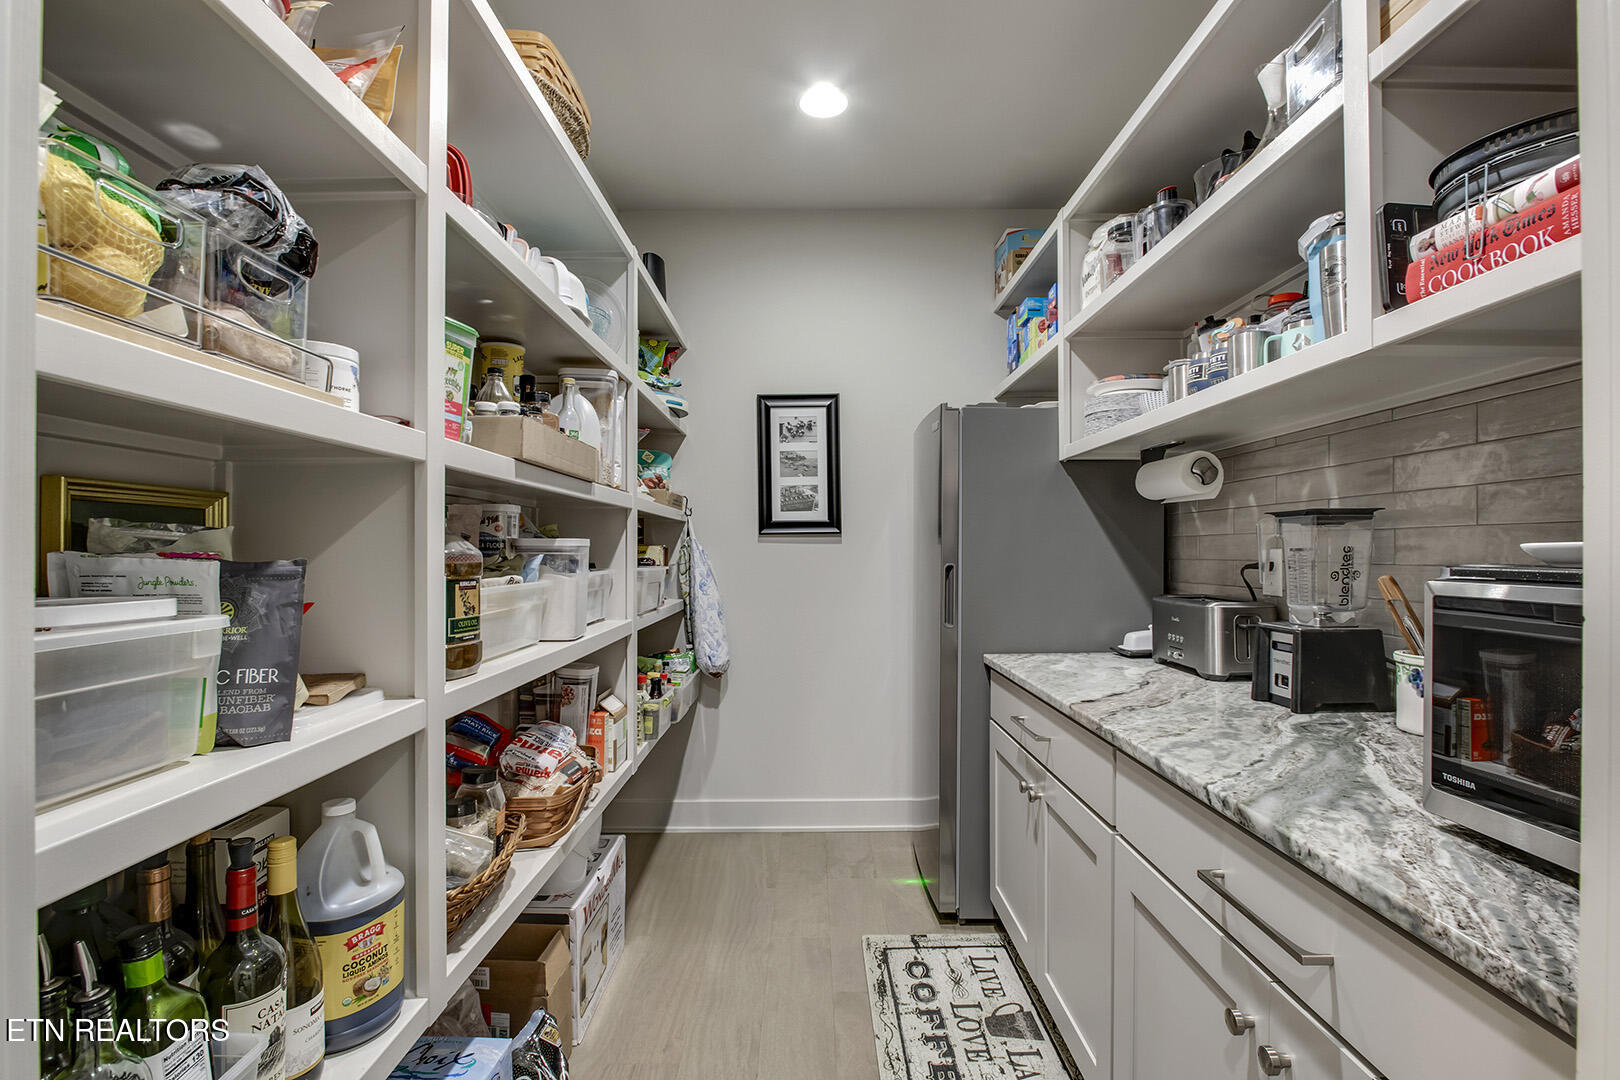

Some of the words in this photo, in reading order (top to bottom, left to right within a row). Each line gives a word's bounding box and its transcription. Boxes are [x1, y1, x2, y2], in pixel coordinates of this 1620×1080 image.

[1502, 203, 1557, 238] Times
[1561, 193, 1571, 235] AMANDA
[1571, 192, 1580, 230] HESSER
[1428, 225, 1557, 294] COOKBOOK
[1188, 366, 1200, 375] ETI
[138, 577, 164, 590] Jungle
[1331, 545, 1354, 607] blendtec
[236, 668, 280, 685] FIBER
[243, 687, 267, 695] FROM
[220, 703, 272, 715] BAOBAB
[1442, 772, 1477, 791] TOSHIBA
[351, 924, 382, 944] BRAGG
[342, 943, 389, 972] COCONUT
[342, 965, 367, 979] LIQUID
[367, 952, 389, 969] AMINOS
[968, 954, 1007, 1000] LIVE
[257, 996, 285, 1020] CASA
[950, 1001, 994, 1064] LOVE
